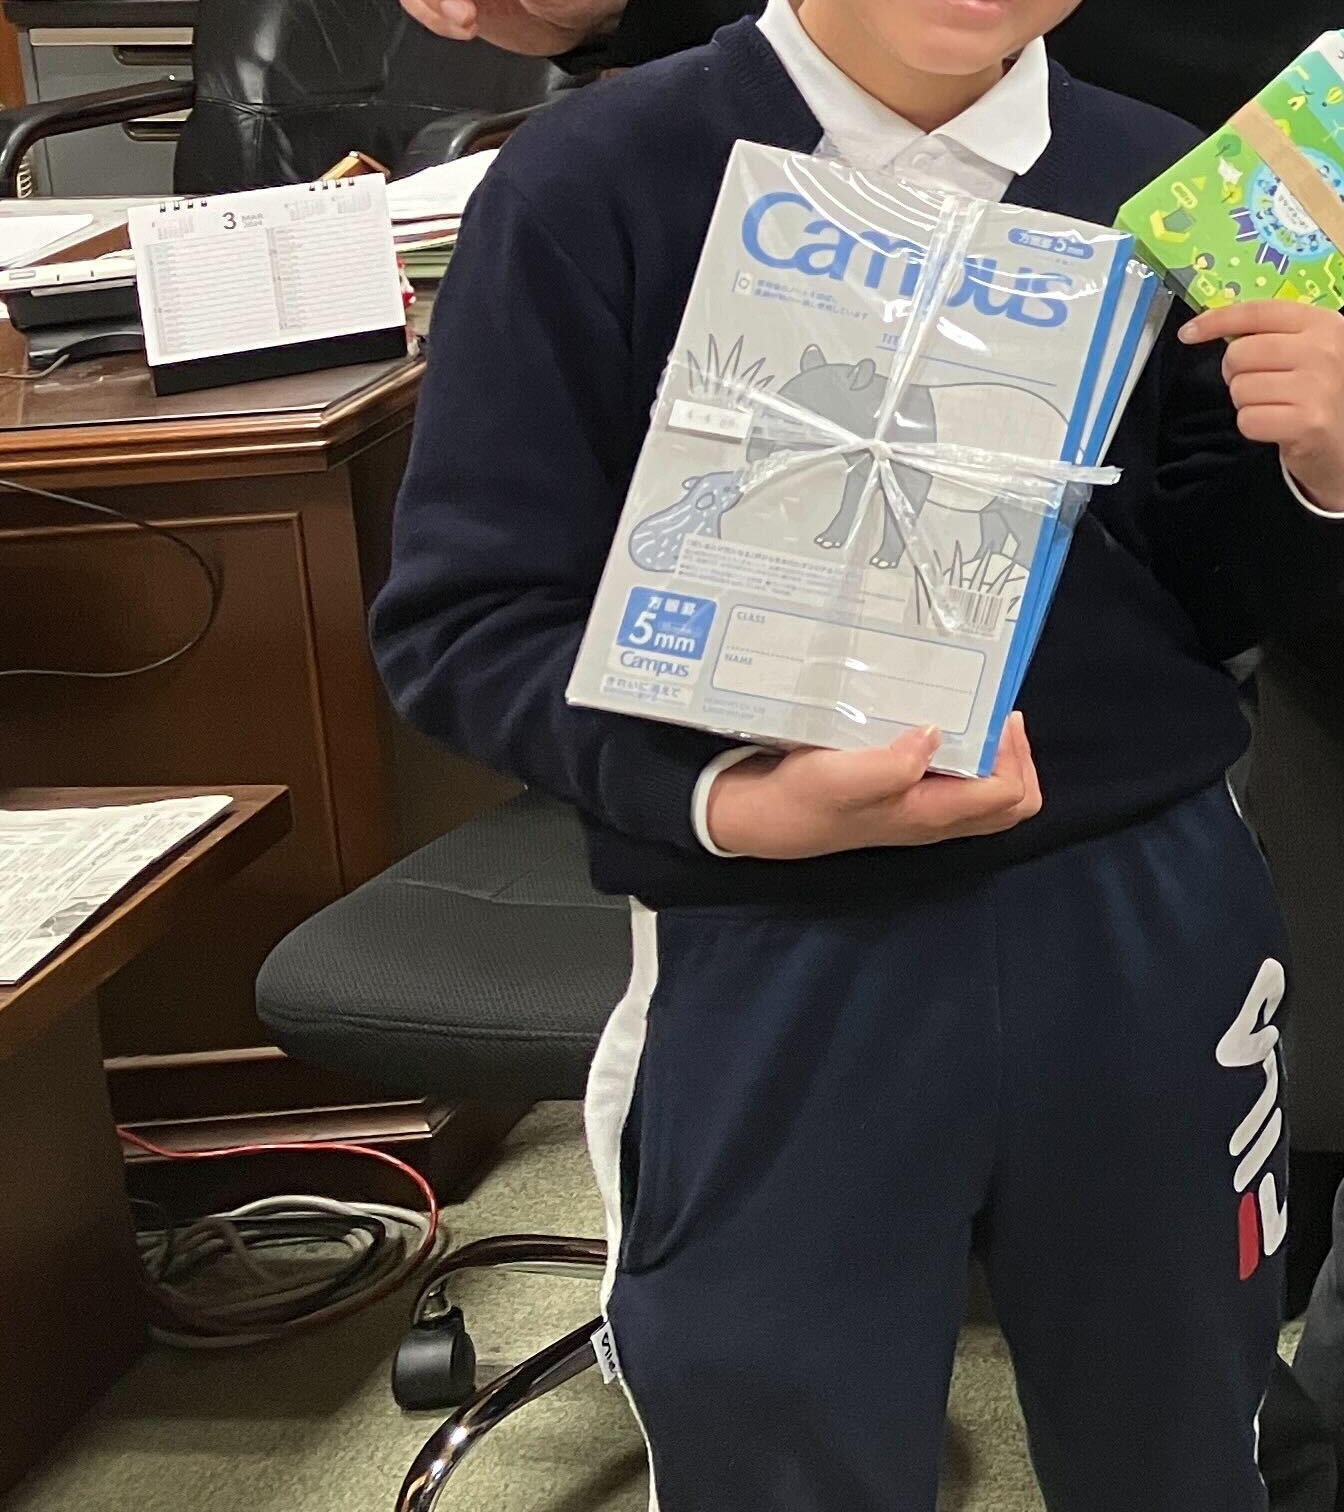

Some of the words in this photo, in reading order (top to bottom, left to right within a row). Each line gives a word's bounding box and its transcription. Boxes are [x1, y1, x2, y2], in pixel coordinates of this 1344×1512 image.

[222, 211, 237, 230] 3
[628, 611, 696, 654] 5mm
[619, 649, 689, 678] Campus
[724, 653, 753, 666] NAME
[1215, 957, 1288, 1281] FILA
